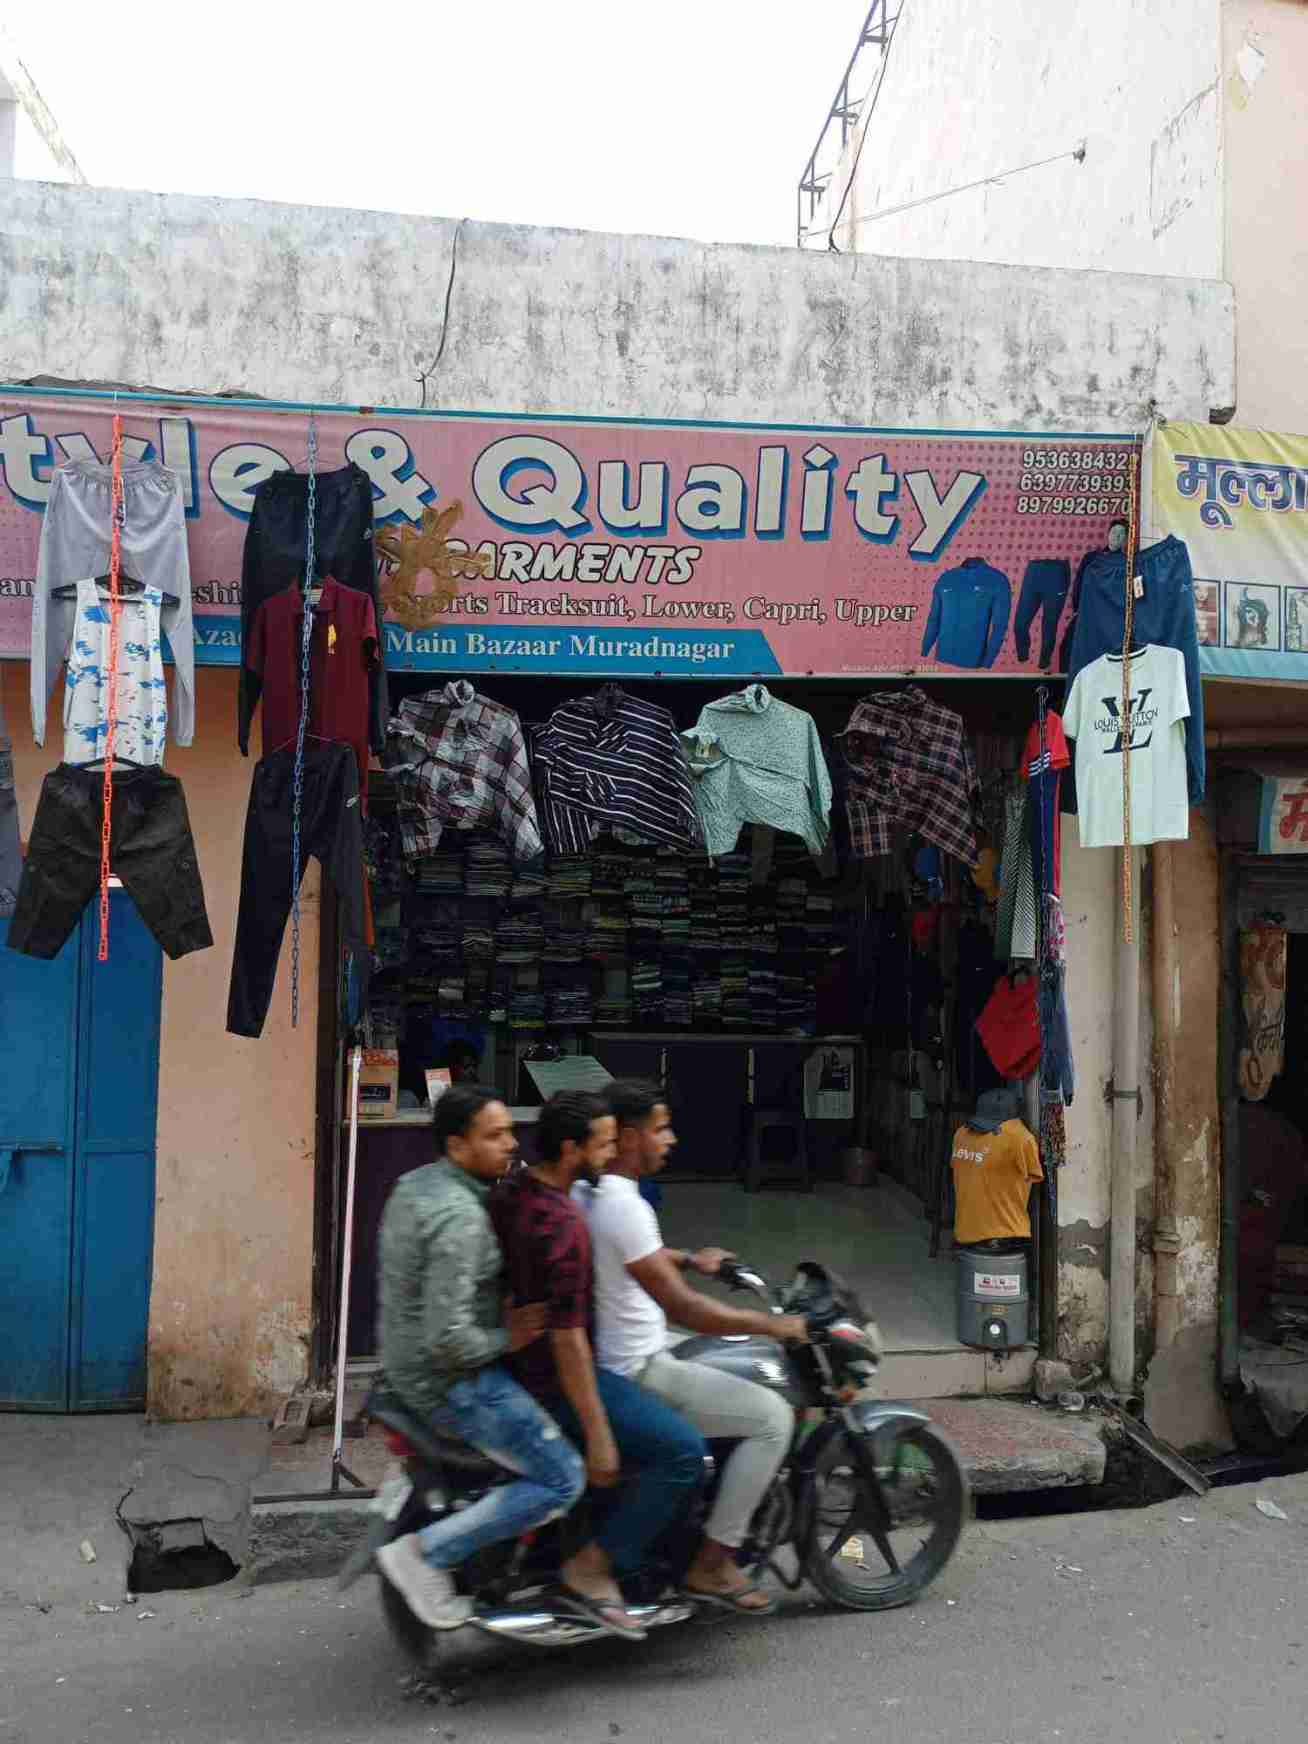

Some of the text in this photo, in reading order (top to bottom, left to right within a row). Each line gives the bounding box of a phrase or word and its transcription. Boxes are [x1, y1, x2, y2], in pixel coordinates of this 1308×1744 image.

[1023, 450, 1136, 470] 953638432
[345, 428, 437, 528] &
[472, 434, 987, 561] Quality
[1016, 496, 1133, 515] 8979926670
[495, 590, 635, 622] Tracksuit,
[642, 593, 735, 623] Lower,
[743, 595, 826, 626] Capri,
[835, 598, 917, 627] Upper
[192, 627, 736, 664] Aza Main Bazaar Muradnagar
